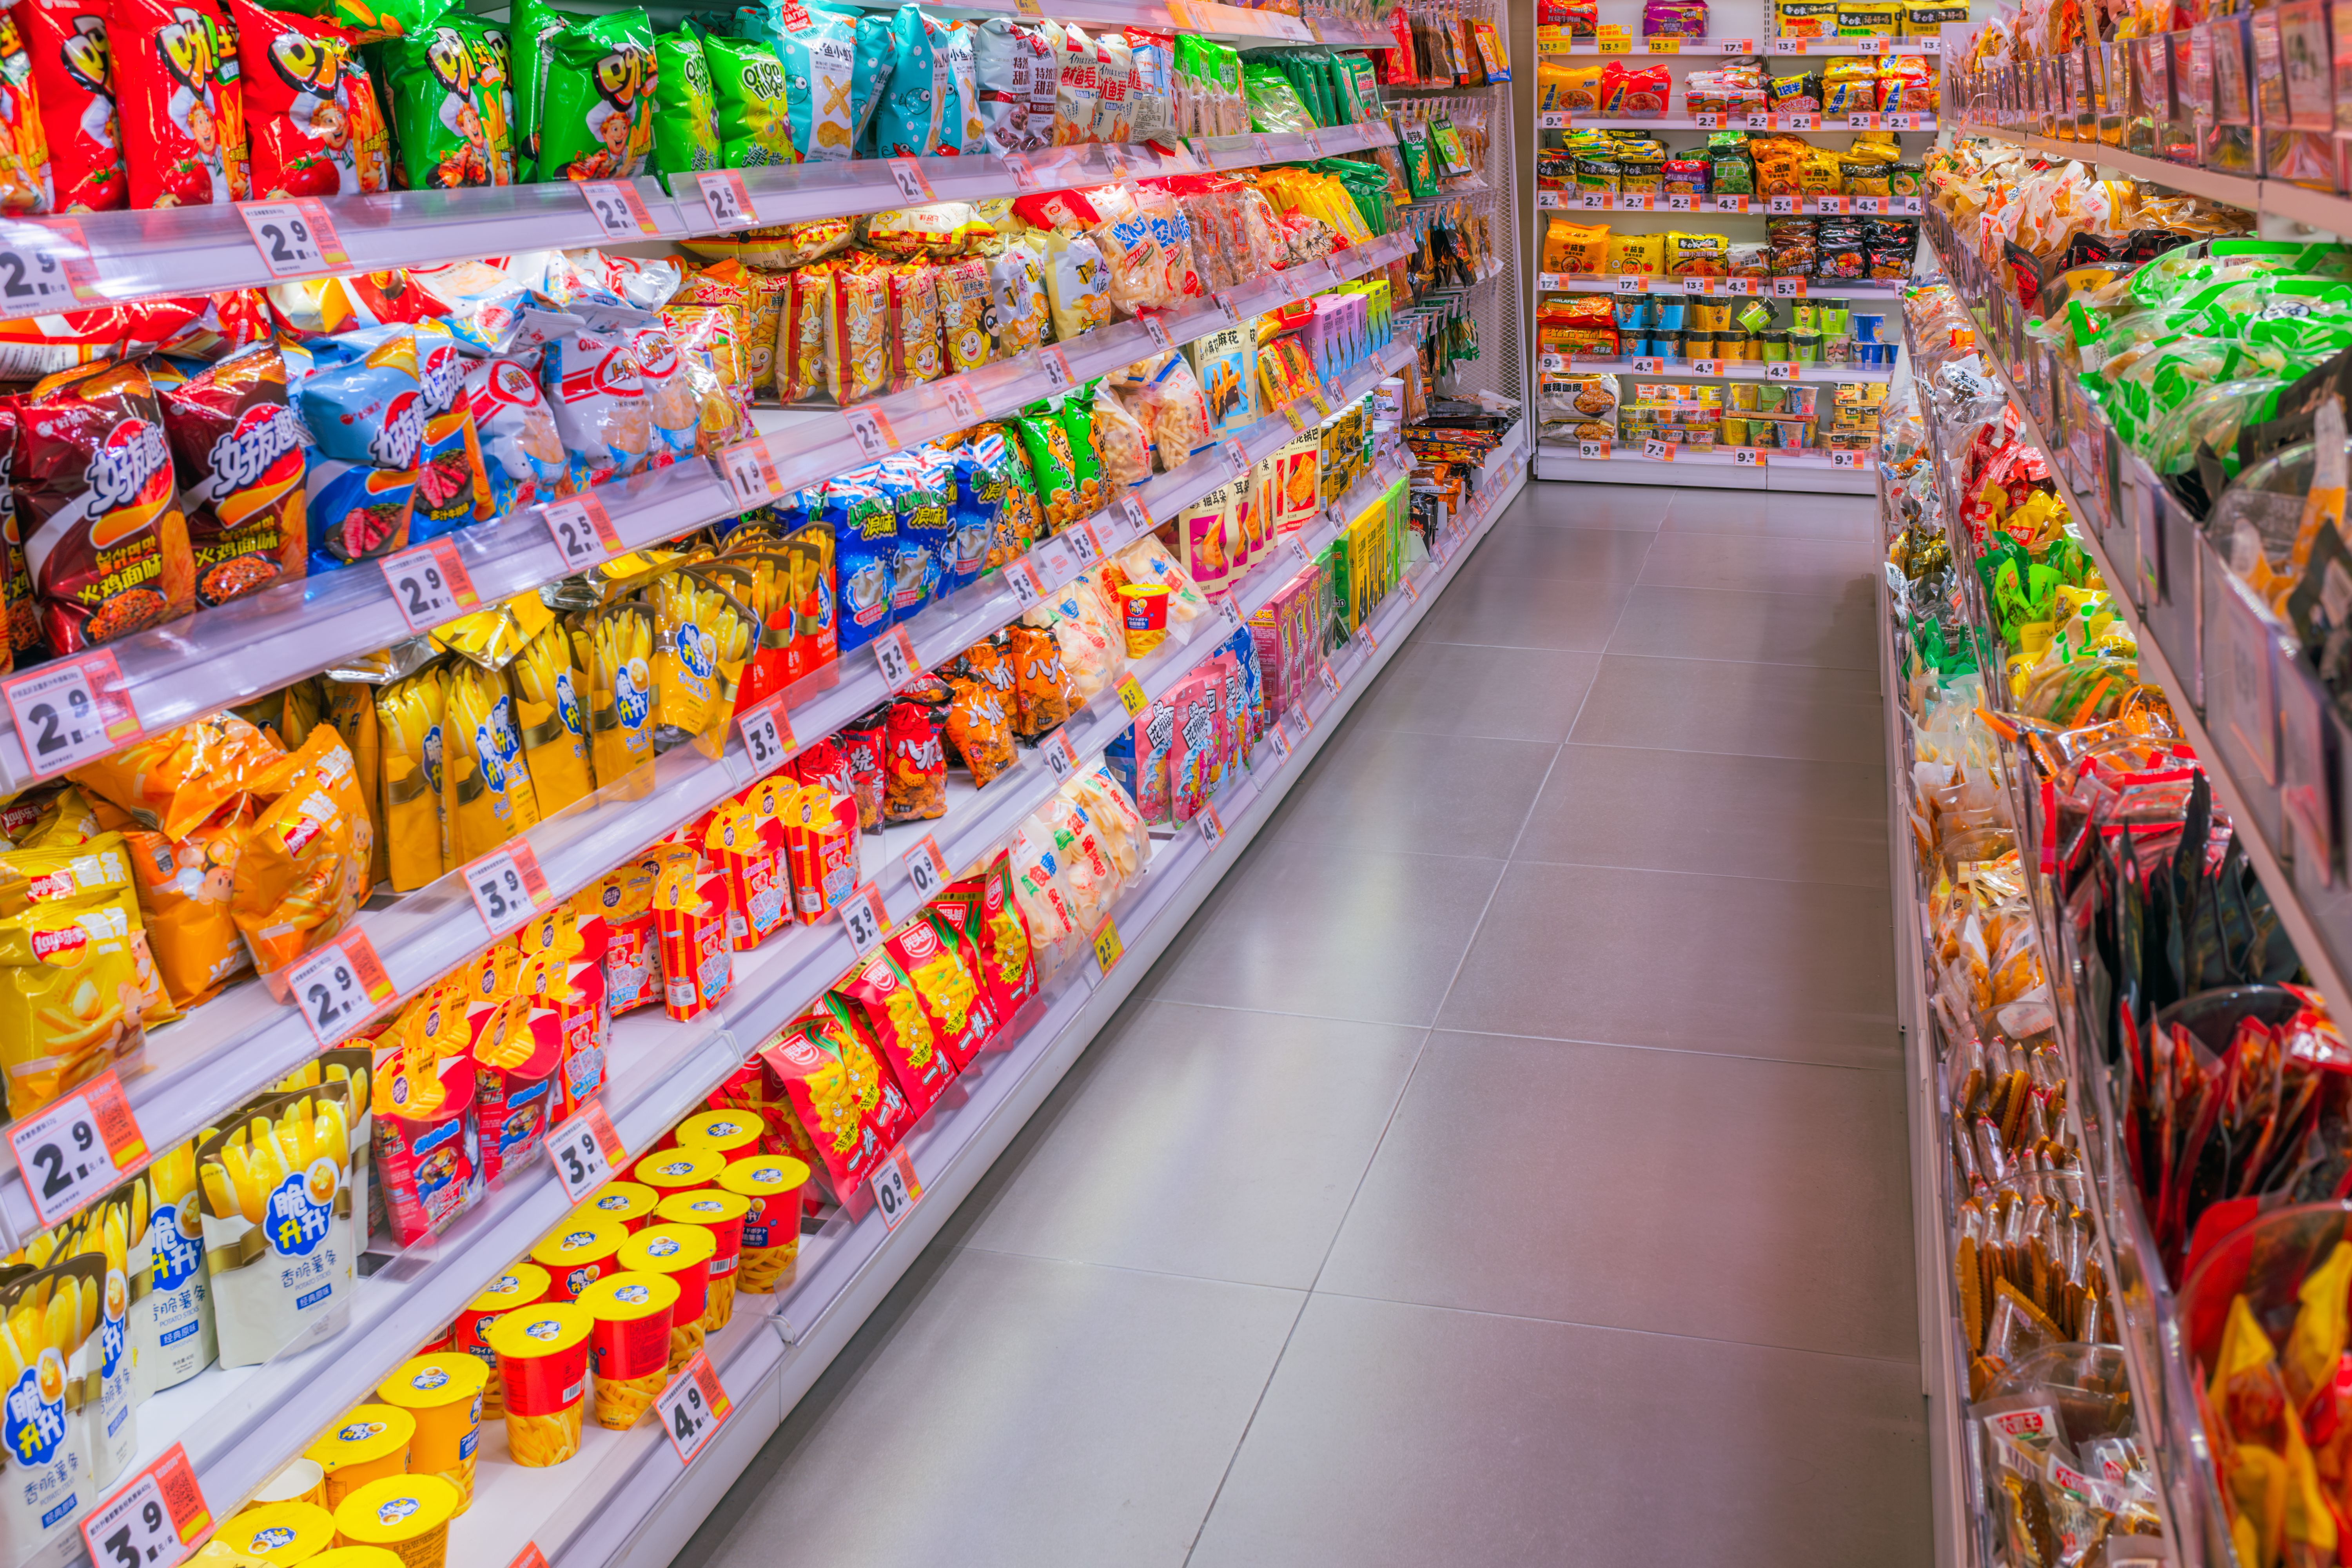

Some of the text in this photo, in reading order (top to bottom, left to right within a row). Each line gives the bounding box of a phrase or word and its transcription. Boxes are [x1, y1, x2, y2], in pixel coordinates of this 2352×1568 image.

[788, 18, 809, 30] CRISP
[1477, 34, 1496, 74] 虎皮凤爪
[1724, 43, 1742, 52] 17.5
[1779, 43, 1796, 52] 13.2
[1861, 44, 1878, 52] 13.2
[1032, 103, 1054, 113] 专注膨化17年
[1546, 117, 1562, 126] 9.9
[1699, 117, 1715, 127] 2.2
[1750, 118, 1766, 127] 2.2
[1793, 119, 1809, 128] 2.8
[1852, 117, 1868, 127] 2.5
[1891, 118, 1907, 127] 2.6
[898, 169, 918, 196] 2.4
[710, 187, 734, 219] 2.5
[1541, 196, 1556, 206] 2.7
[1586, 197, 1601, 207] 2.7
[1626, 198, 1642, 207] 2.7
[1672, 199, 1688, 209] 2.2
[1719, 200, 1735, 210] 4.2
[1775, 201, 1791, 211] 3.6
[1821, 202, 1837, 212] 3.6
[1859, 201, 1877, 211] 4.4
[597, 198, 627, 229] 2.9
[261, 220, 307, 262] 2.9
[900, 236, 916, 245] Oishi
[1125, 244, 1149, 271] HOLLOW
[1140, 245, 1154, 264] CRISP
[954, 261, 987, 283] 上好佳
[963, 281, 985, 293] 鲜虾条
[1686, 283, 1703, 291] 13.2
[1729, 282, 1746, 291] 4.5
[1778, 284, 1794, 294] 5.5
[1149, 328, 1165, 345] 3.9
[1219, 330, 1239, 347] 麻花
[1044, 360, 1063, 384] 3.2
[1635, 362, 1652, 372] 4.9
[1695, 363, 1712, 373] 4.9
[1770, 367, 1788, 377] 4.9
[1543, 383, 1582, 392] 麻辣面皮
[947, 392, 966, 418] 2.5
[855, 419, 879, 448] 2.2
[211, 406, 299, 499] 好友趣
[1232, 453, 1244, 469] 5.8
[1582, 445, 1599, 456] 9.9
[1647, 444, 1664, 456] 7.8
[1737, 453, 1755, 463] 9.9
[1835, 455, 1852, 465] 9.9
[83, 420, 169, 518] 好友趣
[733, 461, 759, 493] 1.9
[1203, 489, 1227, 507] 猫耳朵
[1128, 505, 1143, 528] 2.9
[559, 516, 592, 557] 2.5
[1073, 534, 1089, 558] 3.5
[194, 531, 279, 568] 火鸡面味
[77, 553, 161, 606] 火鸡面味
[1011, 575, 1031, 600] 3.5
[400, 567, 441, 615] 2.9
[879, 645, 902, 680] 3.2
[1122, 690, 1138, 710] 2.5
[28, 689, 90, 756] 2.9
[748, 721, 776, 762] 3.9
[1274, 735, 1283, 756] 4.5
[1049, 747, 1067, 770] 0.9
[1202, 819, 1213, 842] 4.5
[911, 856, 933, 890] 0.9
[480, 870, 520, 918] 3.9
[848, 906, 873, 942] 3.9
[1099, 938, 1113, 966] 2.5
[307, 966, 352, 1029] 2.9
[33, 1121, 93, 1200] 2.9
[561, 1134, 595, 1184] 3.9
[881, 1172, 902, 1214] 0.9
[281, 1249, 338, 1289] 香脆薯条
[298, 1285, 332, 1308] 经典原味
[162, 1322, 198, 1346] 经典原味
[674, 1388, 702, 1441] 4.9
[25, 1450, 79, 1506] 香脆薯条
[44, 1496, 77, 1526] 经典原味
[105, 1501, 163, 1568] 3.9
